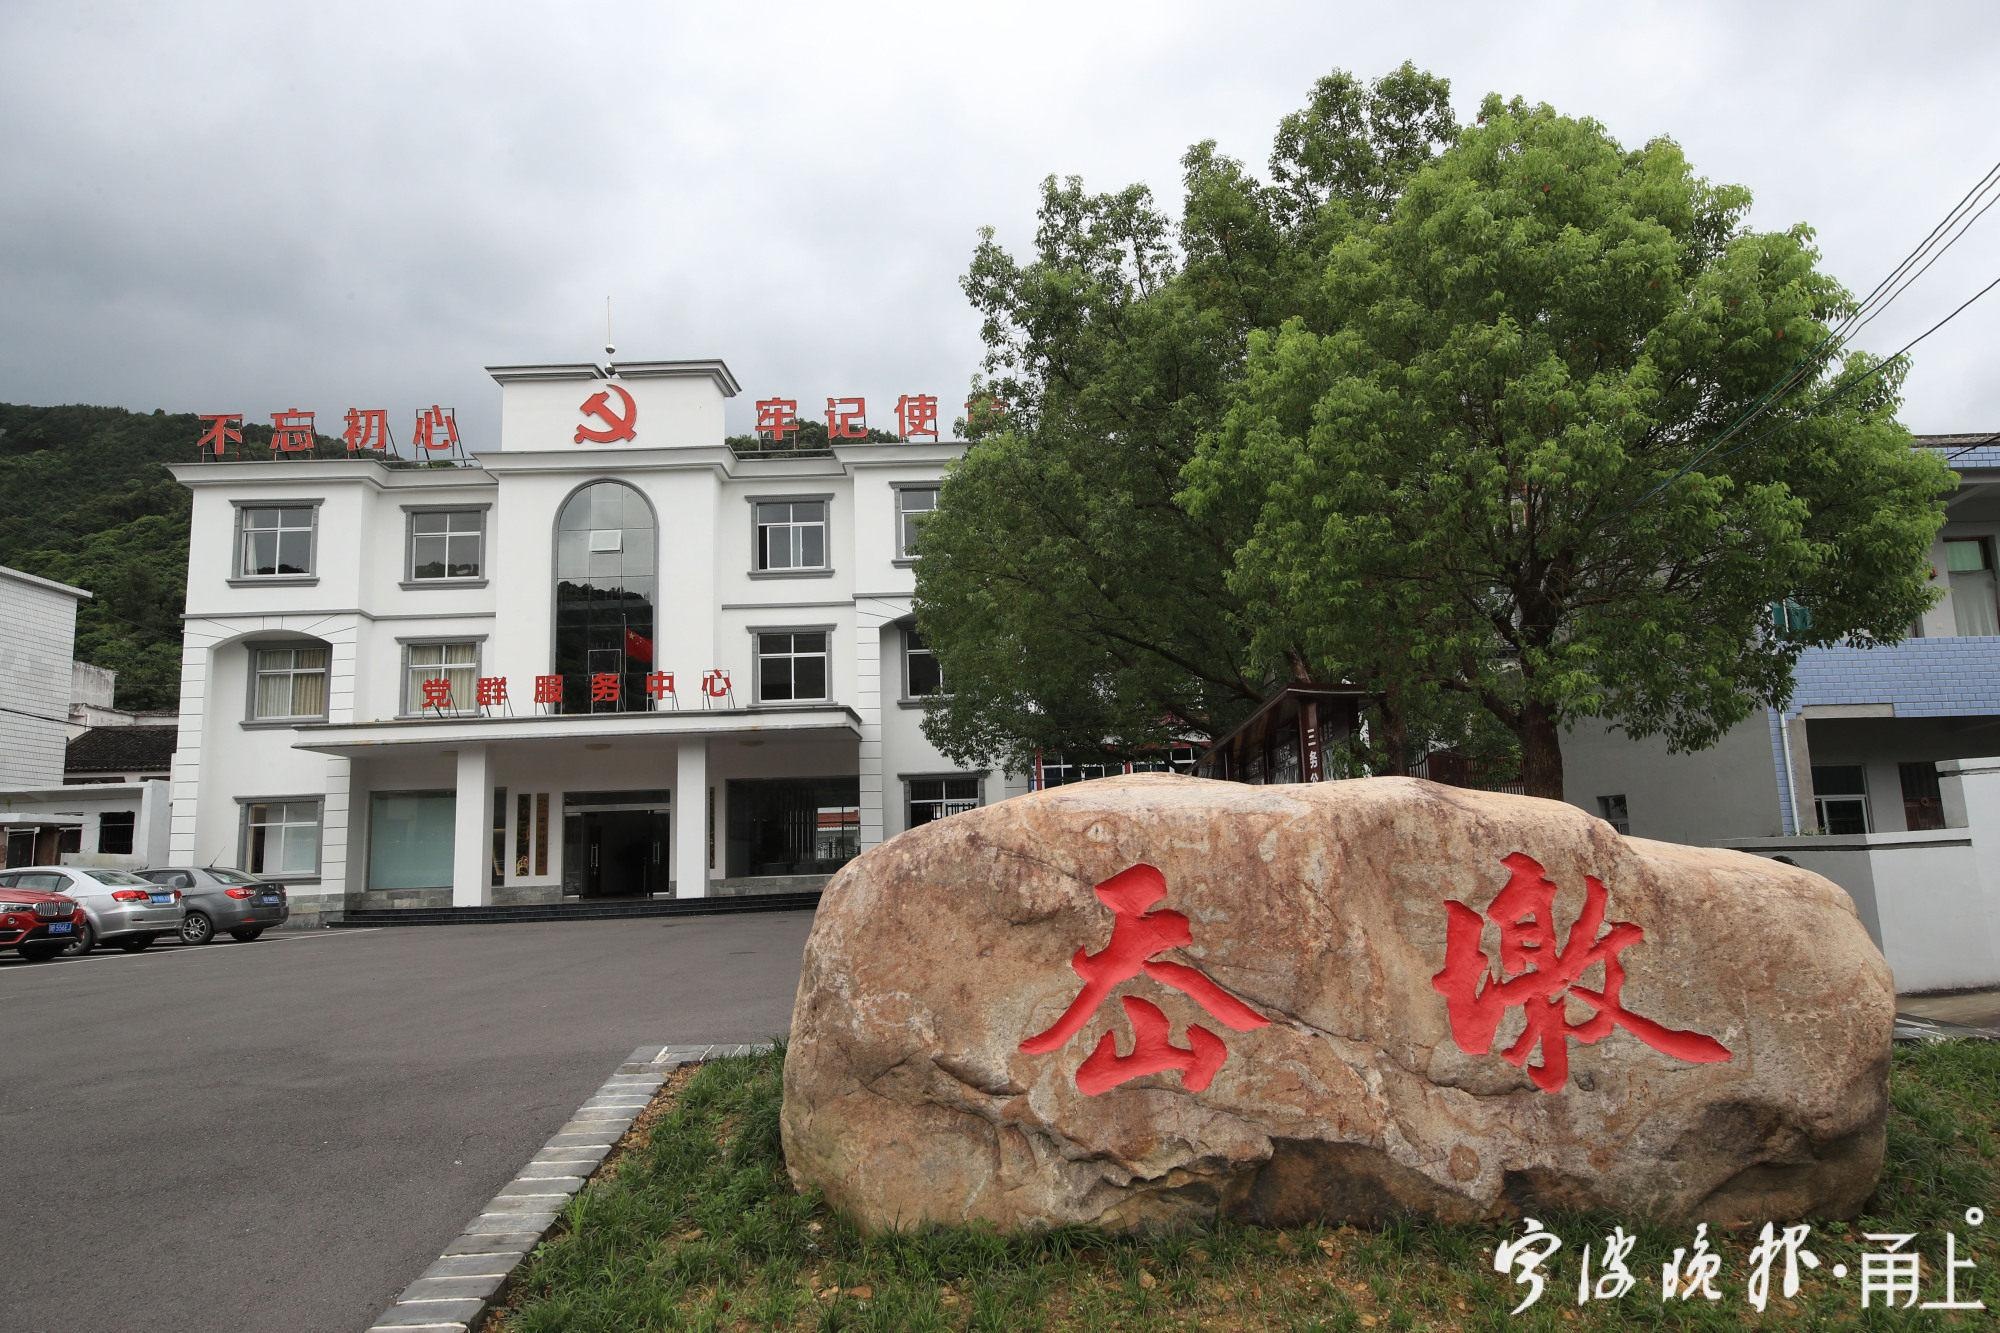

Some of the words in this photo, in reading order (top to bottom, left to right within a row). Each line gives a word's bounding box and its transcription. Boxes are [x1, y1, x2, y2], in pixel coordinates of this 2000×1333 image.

[197, 404, 458, 455] 不忘初心
[421, 667, 732, 708] 党群服务中心
